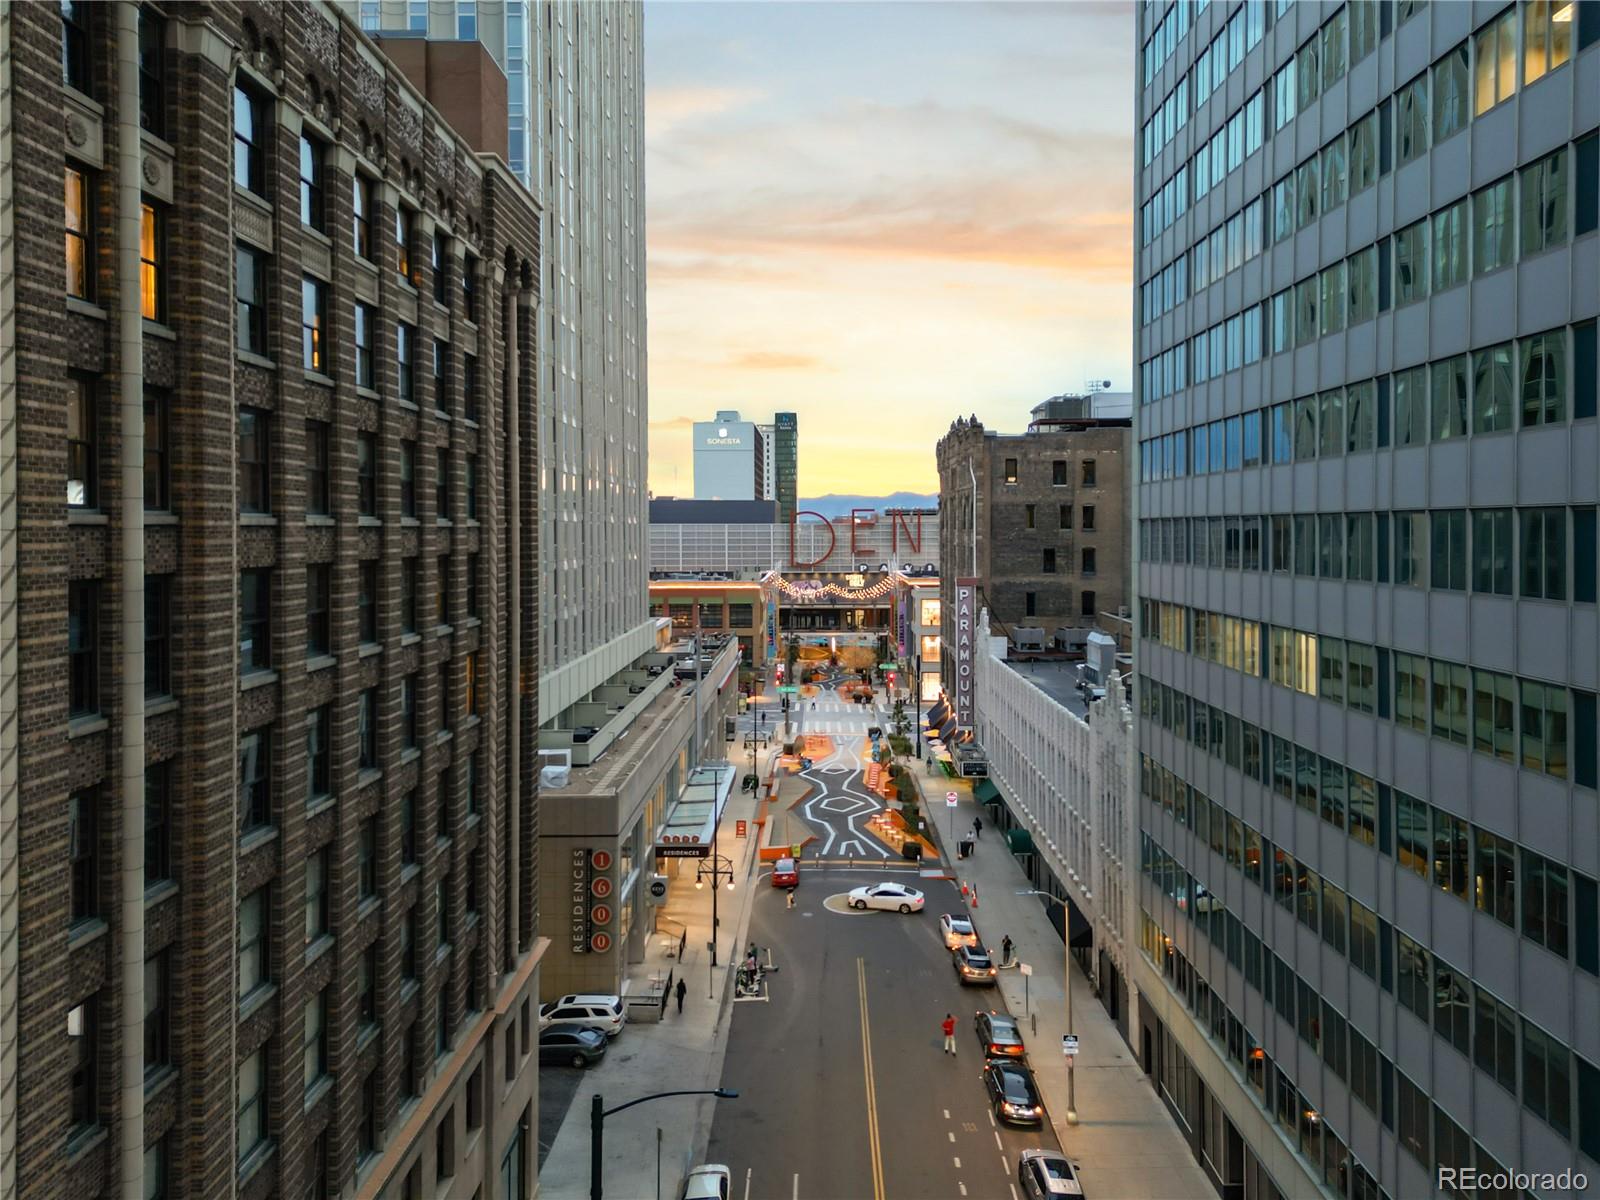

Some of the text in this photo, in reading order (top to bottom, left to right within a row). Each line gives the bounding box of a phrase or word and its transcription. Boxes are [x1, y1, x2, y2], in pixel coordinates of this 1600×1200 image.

[706, 437, 741, 445] SONESTA
[790, 508, 921, 568] DEN
[959, 589, 970, 722] PARAMOUNT
[573, 850, 584, 953] RESIDENCES
